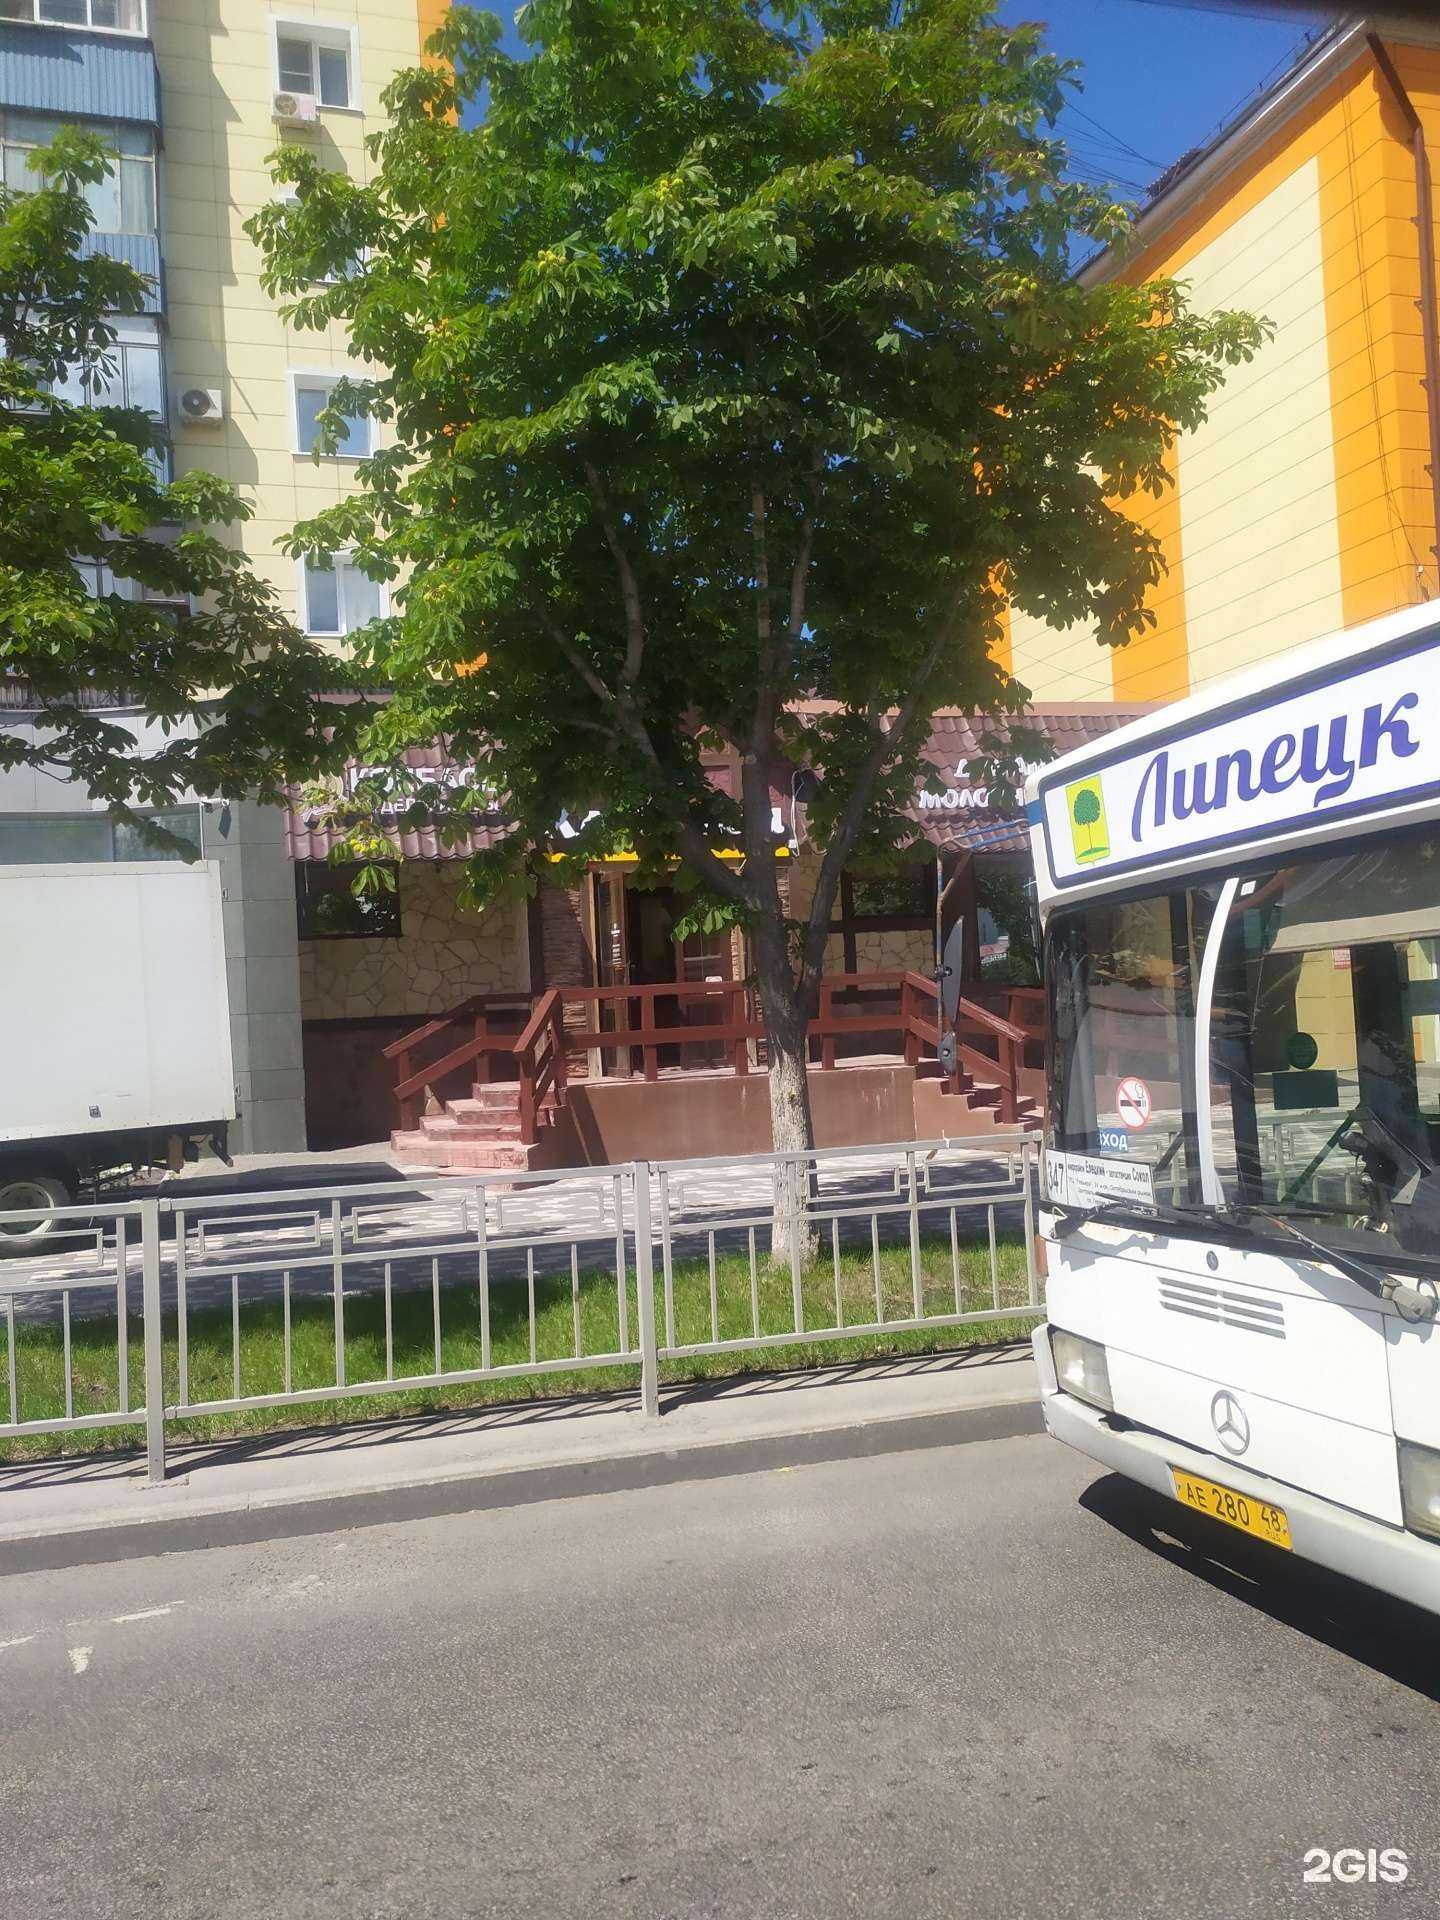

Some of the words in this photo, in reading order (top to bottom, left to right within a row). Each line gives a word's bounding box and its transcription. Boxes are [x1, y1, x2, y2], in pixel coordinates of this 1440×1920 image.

[1131, 692, 1420, 843] Липецк
[1047, 1160, 1065, 1195] 347
[1212, 1488, 1250, 1526] 280
[1261, 1505, 1281, 1532] 48
